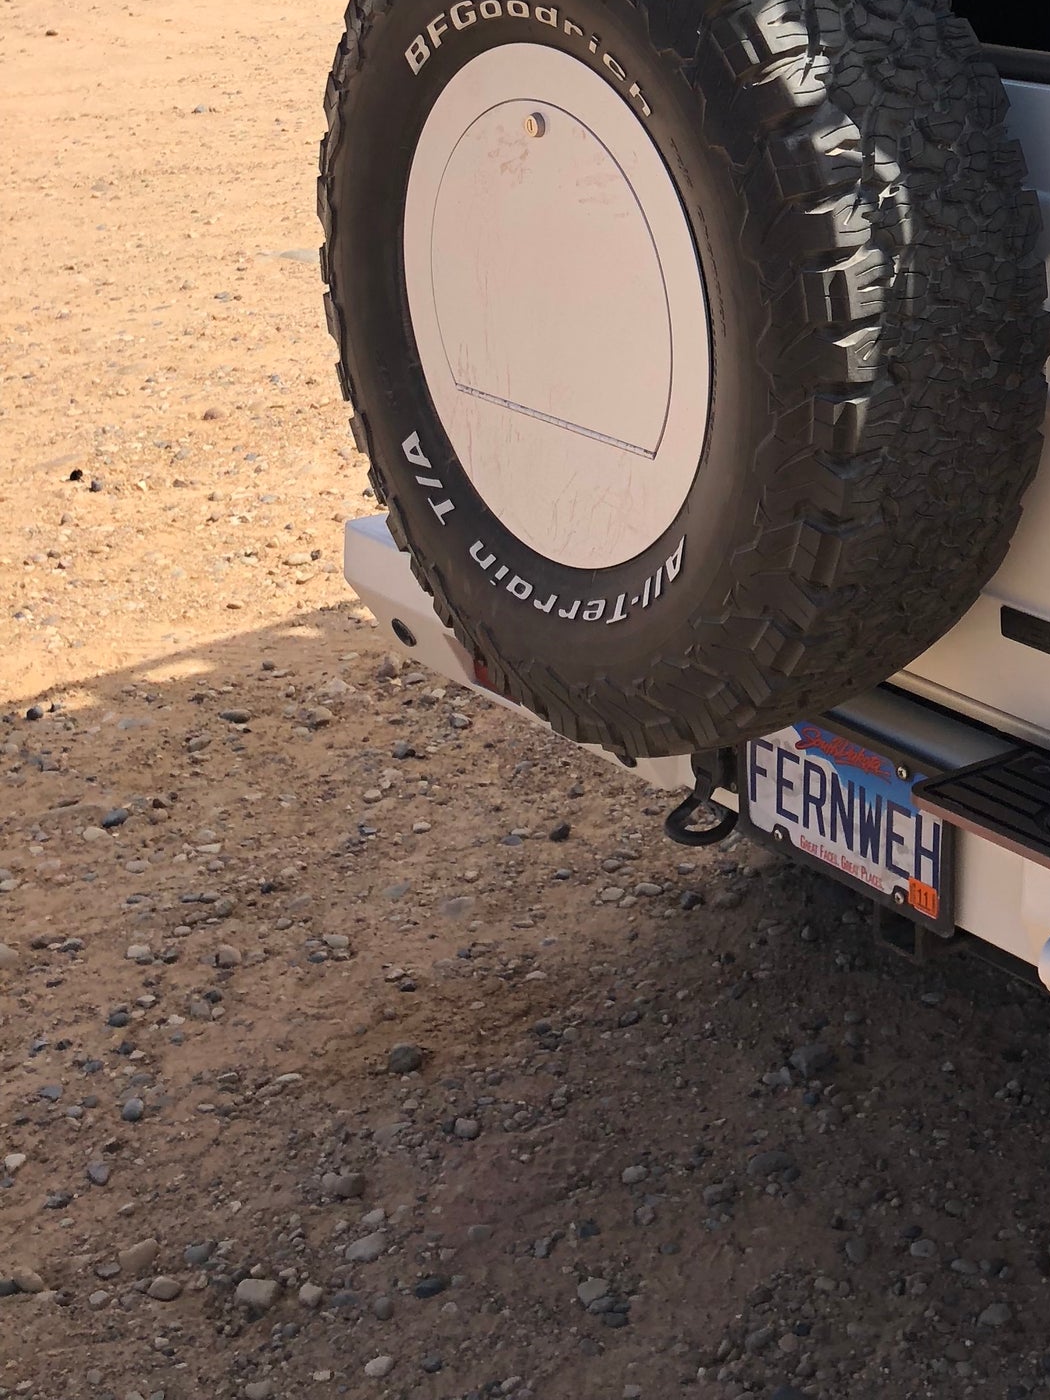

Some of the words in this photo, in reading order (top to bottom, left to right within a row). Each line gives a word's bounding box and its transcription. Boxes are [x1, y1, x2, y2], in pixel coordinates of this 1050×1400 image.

[404, 0, 652, 118] BFGoodrich
[401, 430, 456, 526] T/A
[469, 534, 687, 625] All-Terrain
[750, 738, 941, 892] FERNWEH
